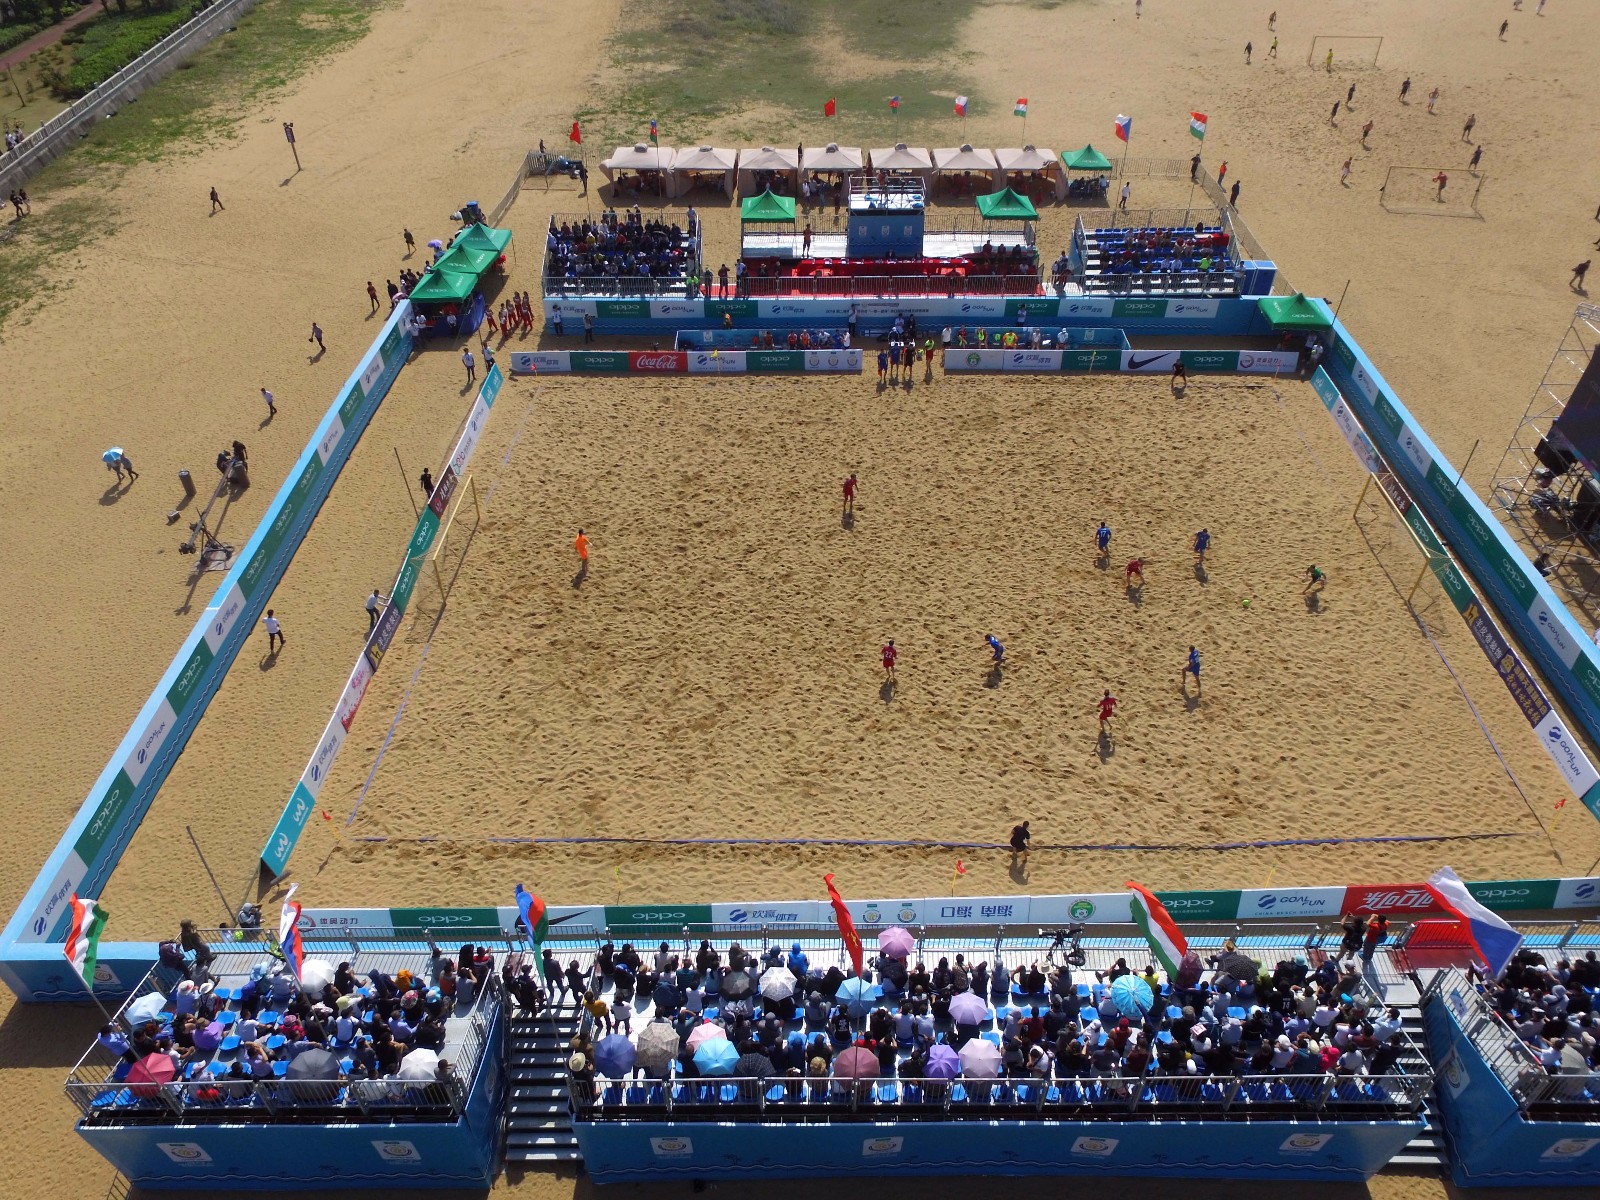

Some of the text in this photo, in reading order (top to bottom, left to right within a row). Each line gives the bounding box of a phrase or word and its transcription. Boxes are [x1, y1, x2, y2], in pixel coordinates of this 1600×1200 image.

[636, 354, 678, 369] Coca-Cola
[1476, 888, 1530, 898] oppo
[418, 916, 472, 924] oppo
[632, 912, 686, 921] oppo
